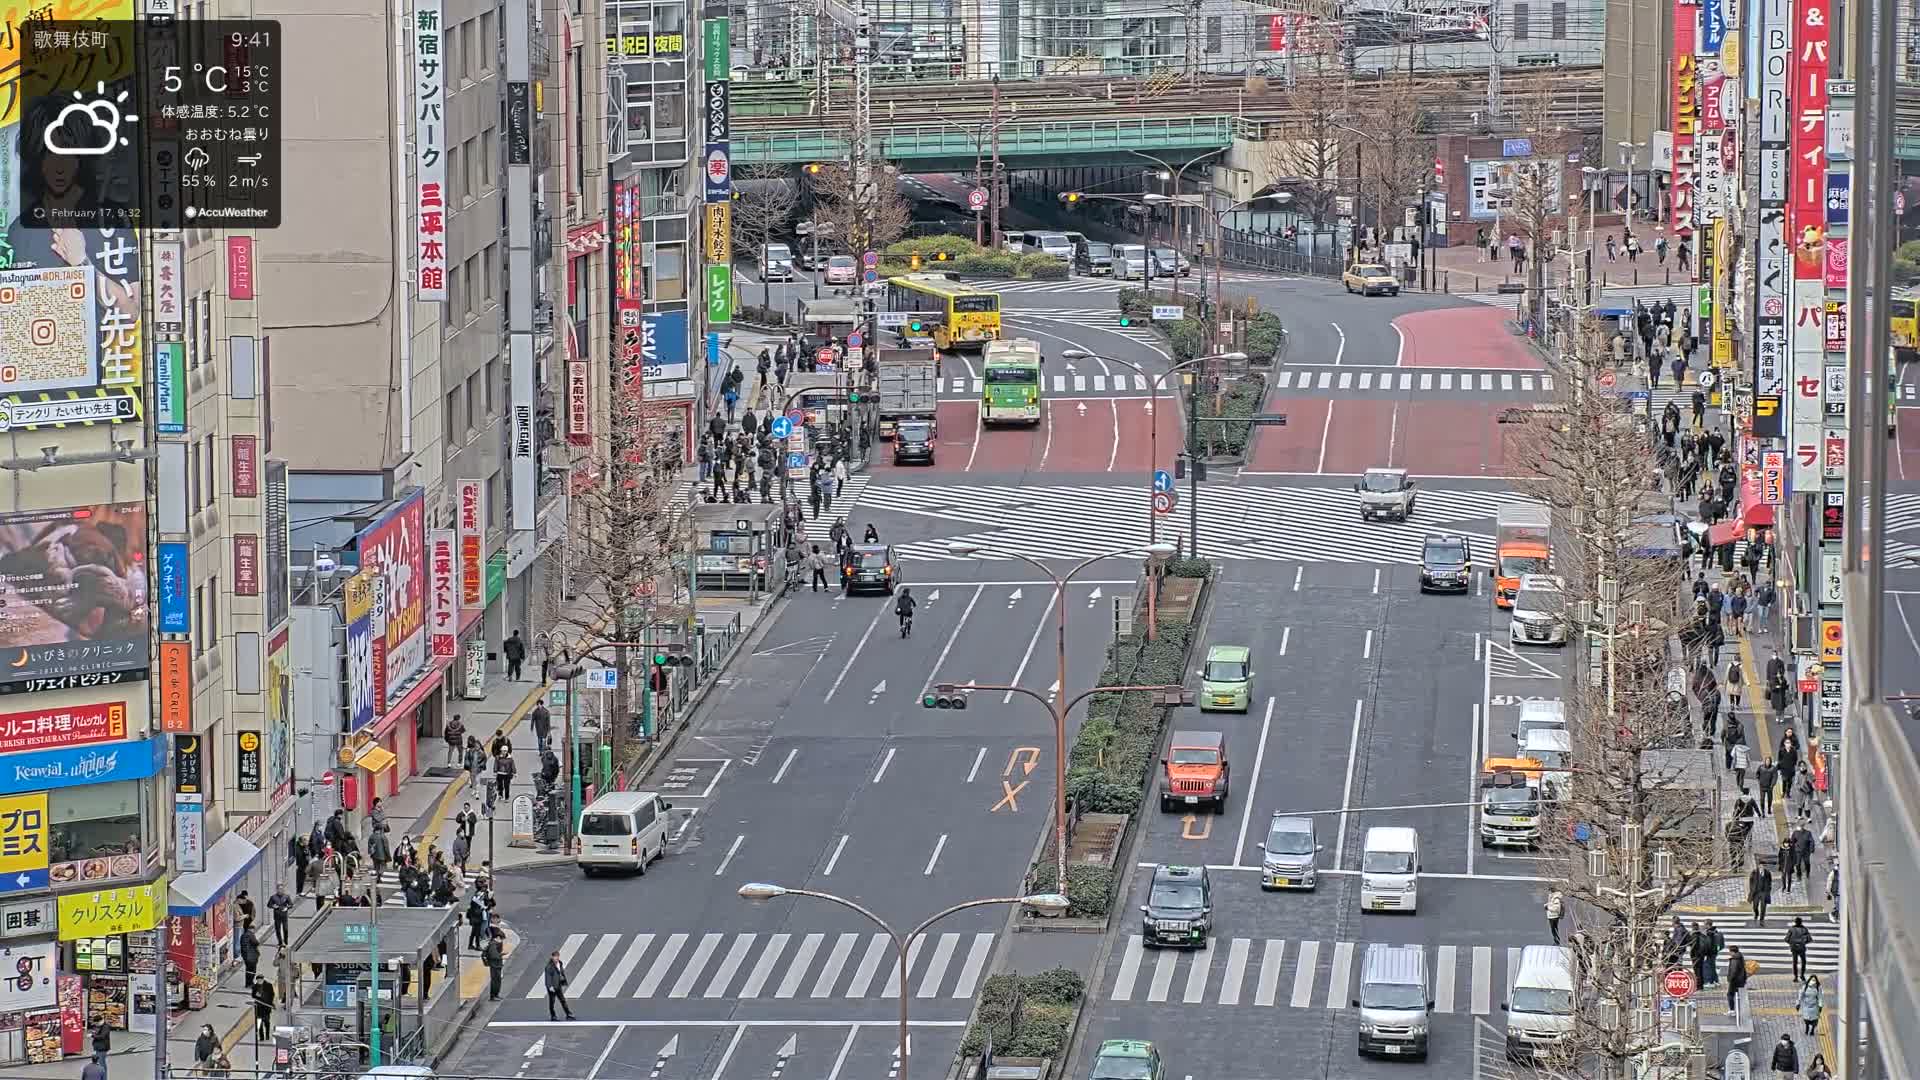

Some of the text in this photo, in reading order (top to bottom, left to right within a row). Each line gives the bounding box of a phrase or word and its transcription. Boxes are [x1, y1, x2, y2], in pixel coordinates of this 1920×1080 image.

[417, 10, 441, 168] 新宿サンパーク
[1678, 55, 1696, 134] パチンコ
[1707, 86, 1719, 118] アコム
[709, 159, 727, 176] 薬
[1675, 145, 1694, 231] エスパス
[1770, 151, 1778, 198] ESOLA
[418, 182, 445, 290] 三平本館
[713, 206, 725, 260] 肉汁水餃子
[712, 273, 725, 312] レイク
[1762, 328, 1774, 380] 大衆酒場
[159, 352, 170, 413] FamilyMart
[1797, 306, 1822, 467] パセラ
[15, 402, 114, 418] テンクリ たいせい先生
[1830, 404, 1844, 413] 5F
[516, 406, 529, 458] HOMEGAME
[462, 485, 475, 529] GAME
[1829, 496, 1841, 504] 3F
[163, 553, 174, 604] ゲウチャイ
[434, 541, 449, 628] 三平ストア
[170, 648, 180, 673] CAFE
[168, 720, 183, 729] B2
[3, 809, 41, 832] プロ
[3, 835, 42, 856] ミス
[7, 909, 41, 929] 囲碁
[72, 902, 144, 925] クリスタル
[327, 988, 344, 1002] 12
